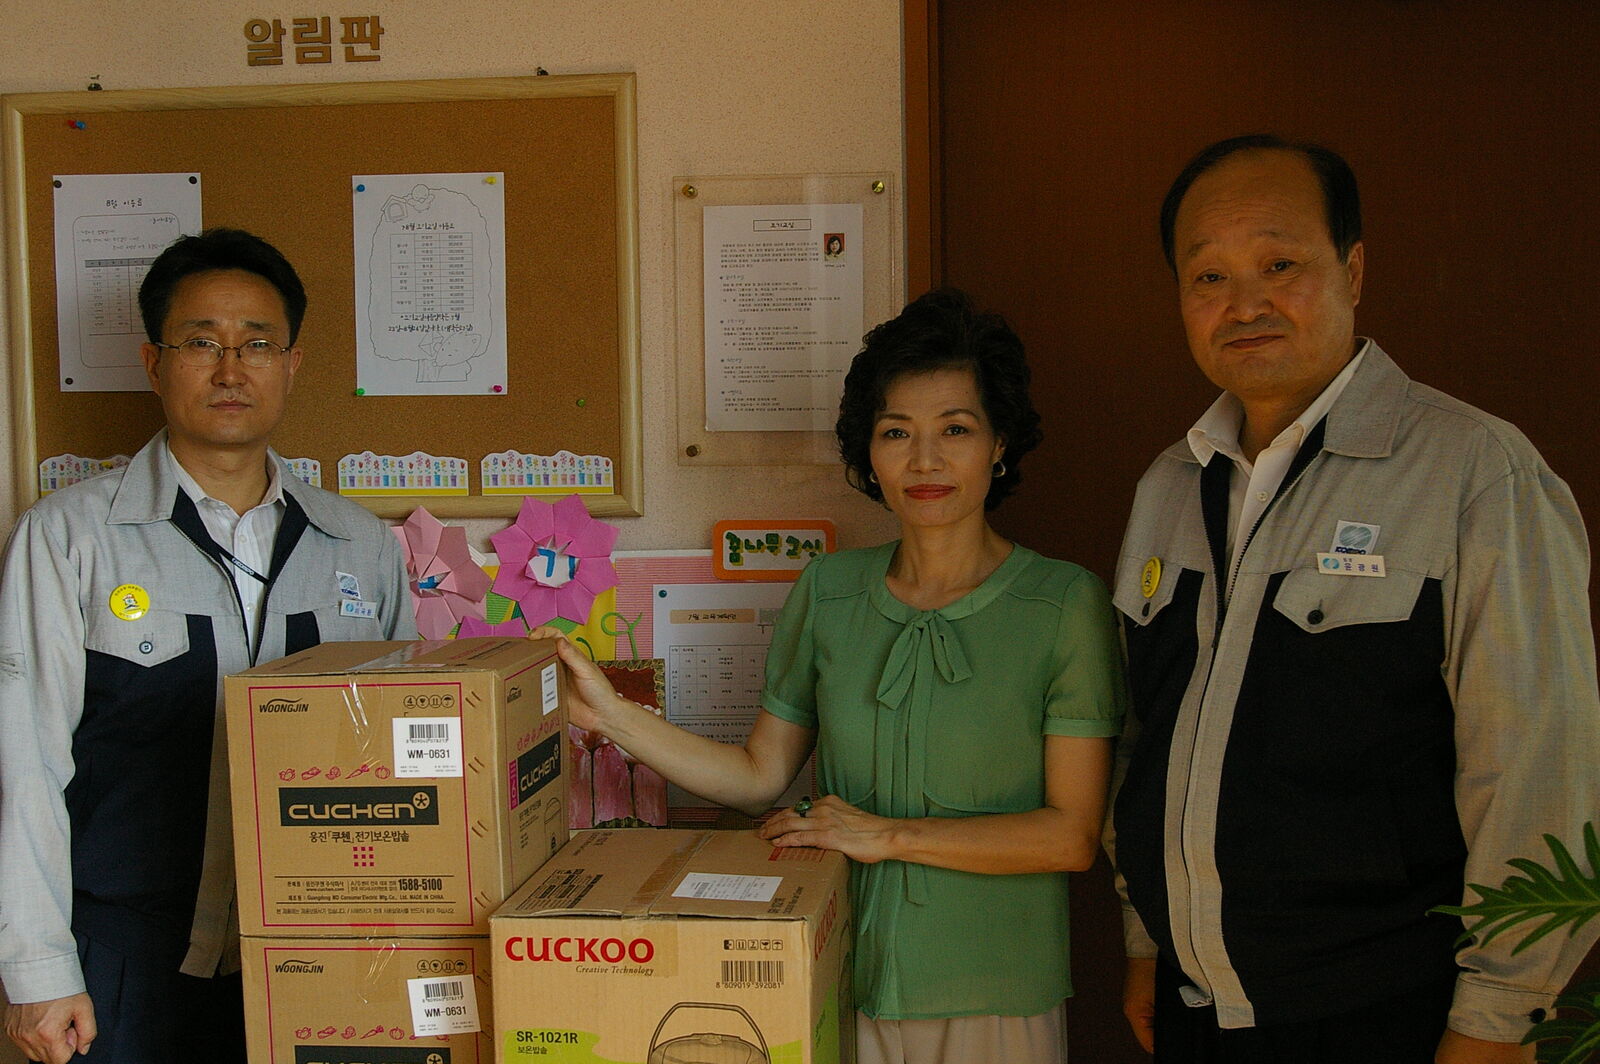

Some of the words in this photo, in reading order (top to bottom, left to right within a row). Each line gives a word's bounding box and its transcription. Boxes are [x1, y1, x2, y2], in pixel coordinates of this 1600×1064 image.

[242, 14, 385, 67] 알림판
[726, 532, 781, 566] 꿈나무
[259, 702, 309, 713] WOONGJIN
[407, 749, 450, 759] WM-0631
[520, 755, 556, 791] CUCHEN
[288, 800, 415, 820] CUCHEN
[398, 878, 442, 890] 1588-5100
[505, 936, 654, 963] CUCKOO
[275, 962, 324, 974] WOONGJIN
[575, 966, 608, 974] Creative
[611, 966, 654, 976] Technology
[424, 1006, 467, 1018] WM-0631
[516, 1031, 578, 1044] SR-1021R
